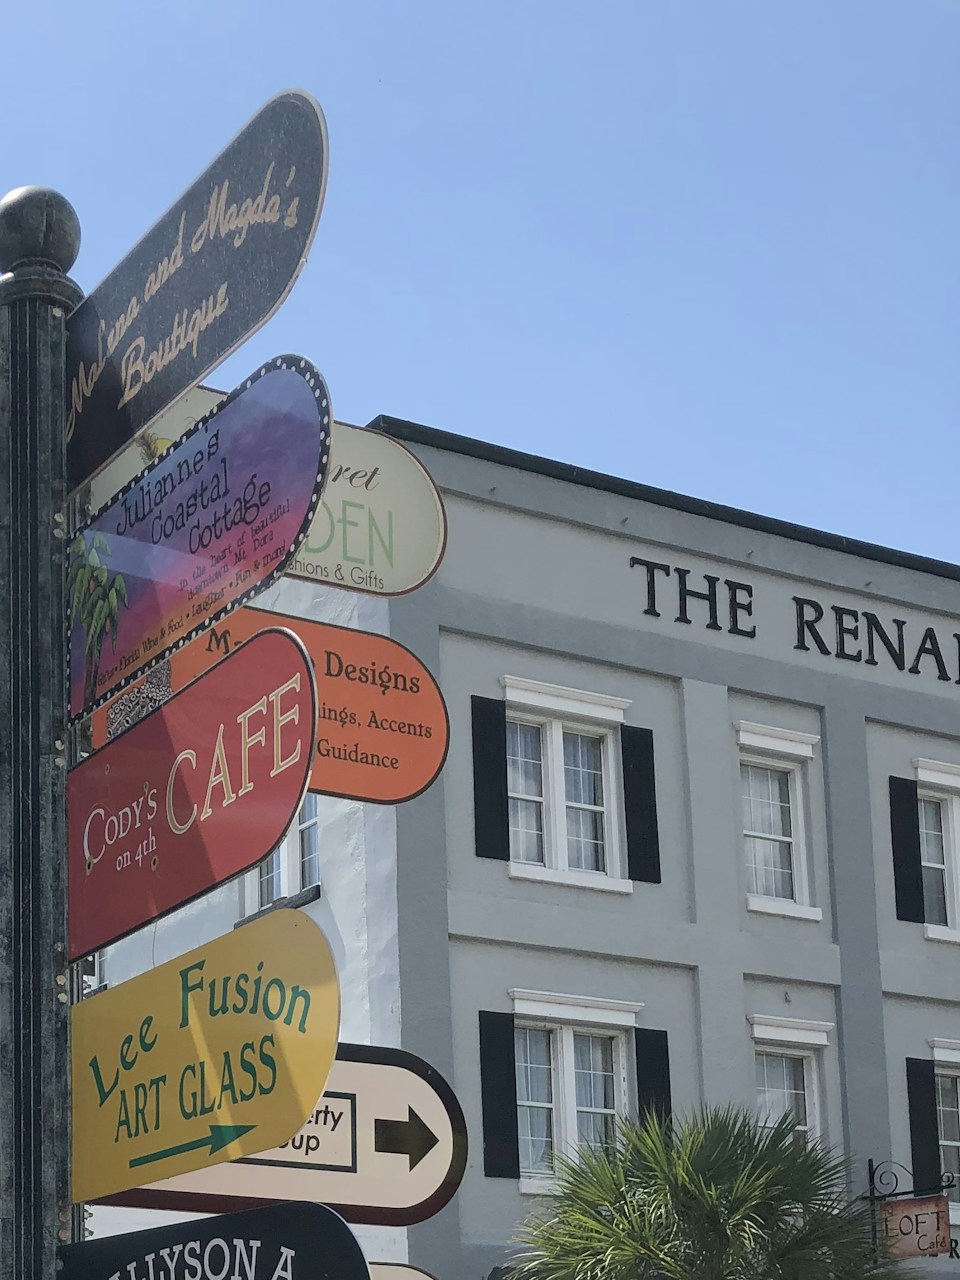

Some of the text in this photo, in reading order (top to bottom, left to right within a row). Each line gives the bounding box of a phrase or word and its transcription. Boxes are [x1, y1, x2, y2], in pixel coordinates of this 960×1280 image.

[143, 211, 187, 304] and
[191, 161, 300, 254] Magda's
[118, 281, 229, 410] Boutique
[116, 425, 220, 535] Julianne's
[151, 457, 229, 545] Coastal
[189, 473, 272, 554] Cottage
[334, 563, 344, 581] &
[350, 566, 384, 590] Gifts
[630, 556, 756, 639] THE
[324, 651, 421, 695] Designs
[166, 672, 304, 836] CAFE
[317, 738, 399, 770] Guidance
[319, 702, 432, 739] ings, Accents
[115, 829, 158, 872] on 4th
[88, 959, 311, 1108] Lee Fusion
[114, 1033, 278, 1143] ART GLASS
[885, 1210, 946, 1238] LOFT
